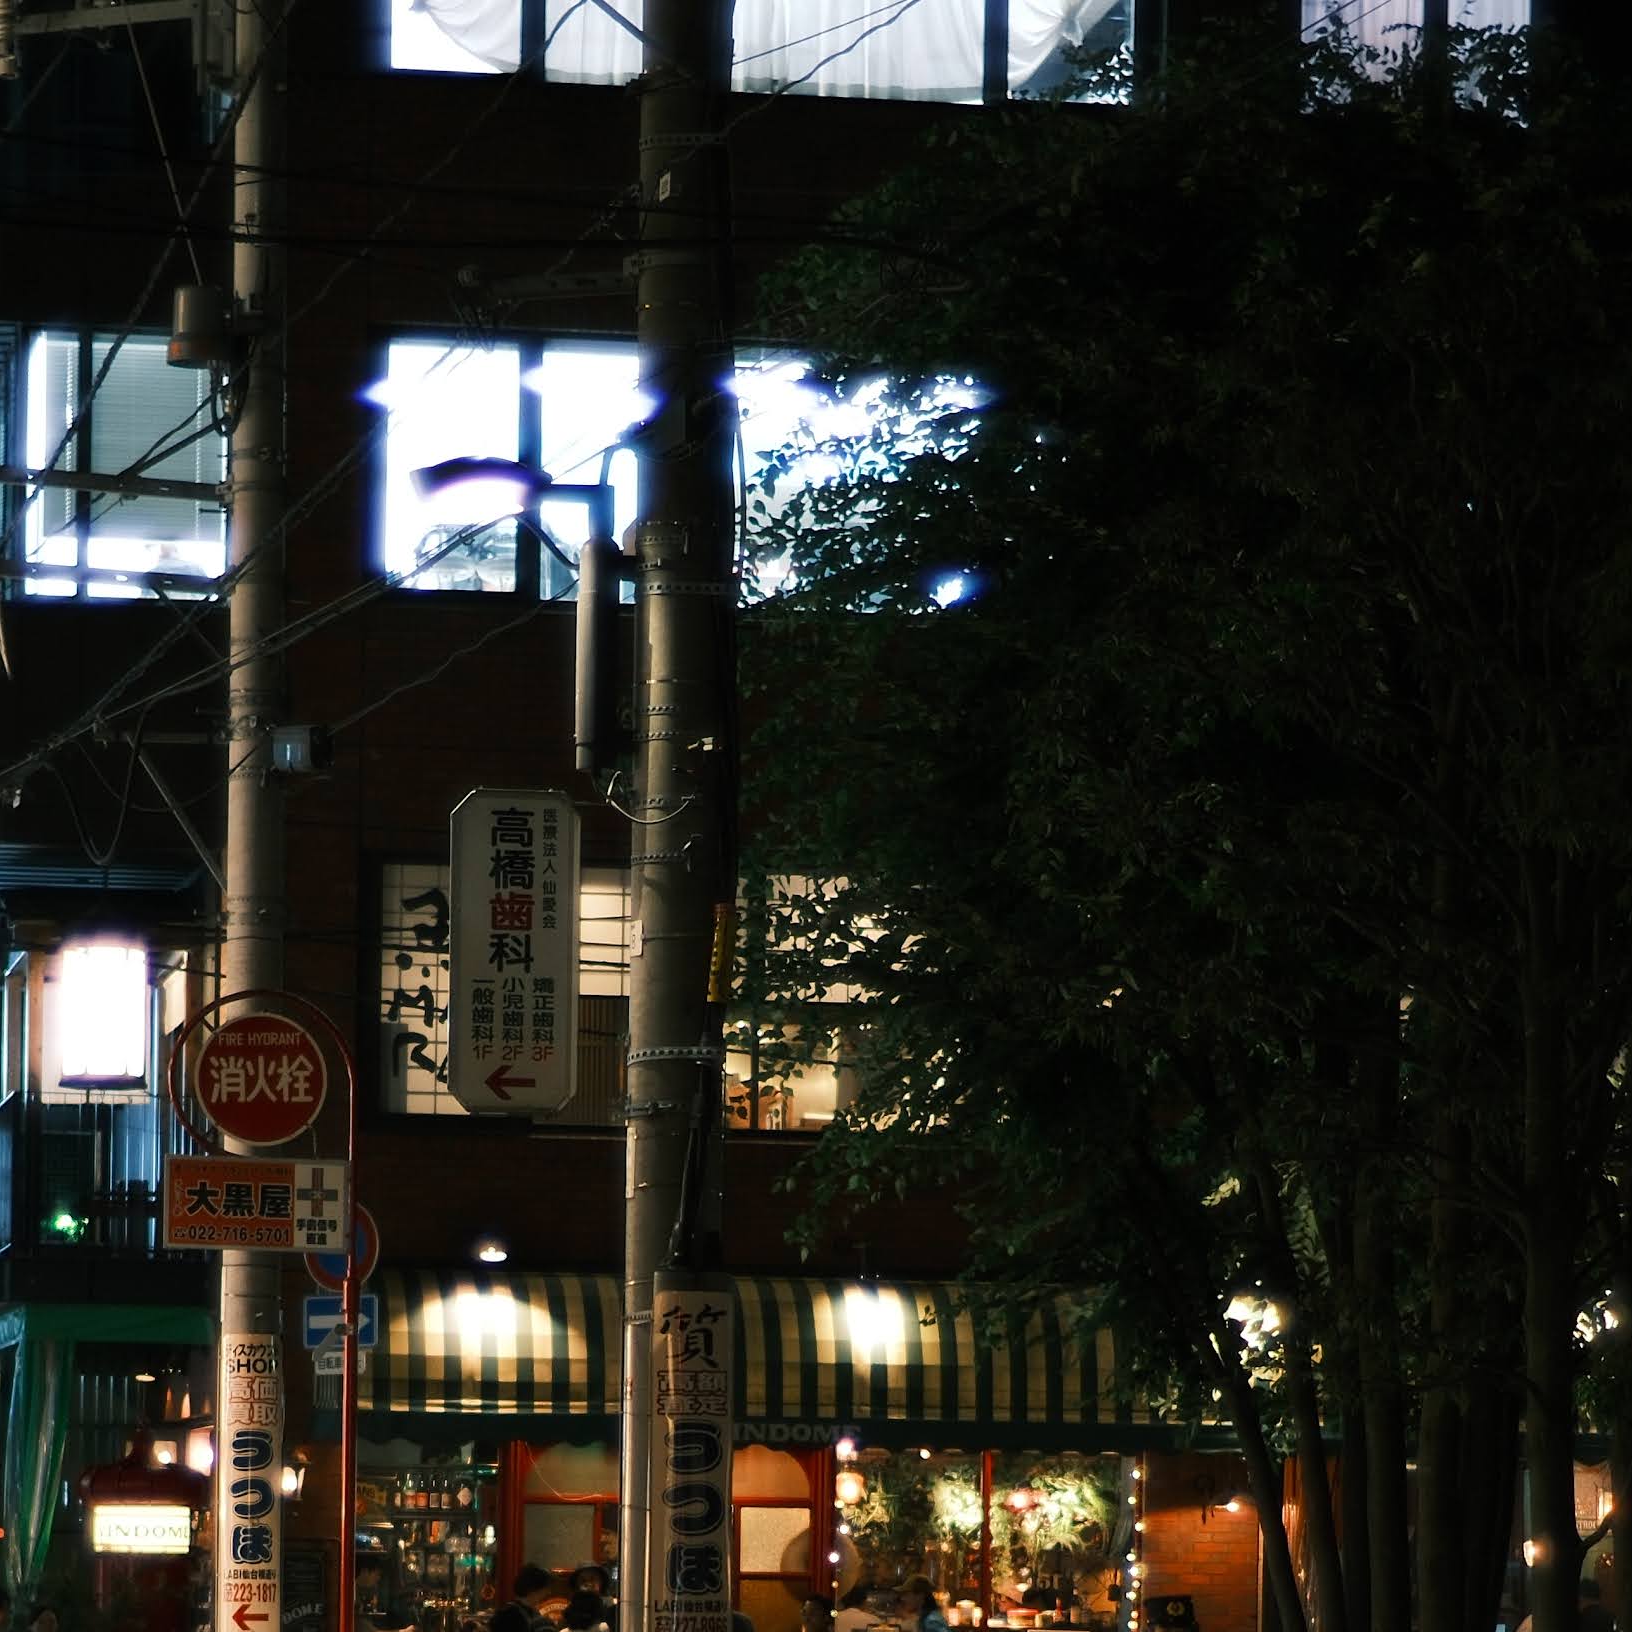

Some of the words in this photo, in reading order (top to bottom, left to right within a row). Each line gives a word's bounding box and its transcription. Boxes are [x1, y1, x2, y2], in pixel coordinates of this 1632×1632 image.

[488, 806, 536, 973] 高橋歯科
[218, 1031, 244, 1046] FIRE
[248, 1031, 302, 1046] HYDRANT
[209, 1055, 315, 1104] 消火栓
[185, 1180, 293, 1220] 大黒屋
[188, 1225, 291, 1244] 022-716-5701
[660, 1303, 728, 1368] 質
[233, 1583, 277, 1603] 223-1817
